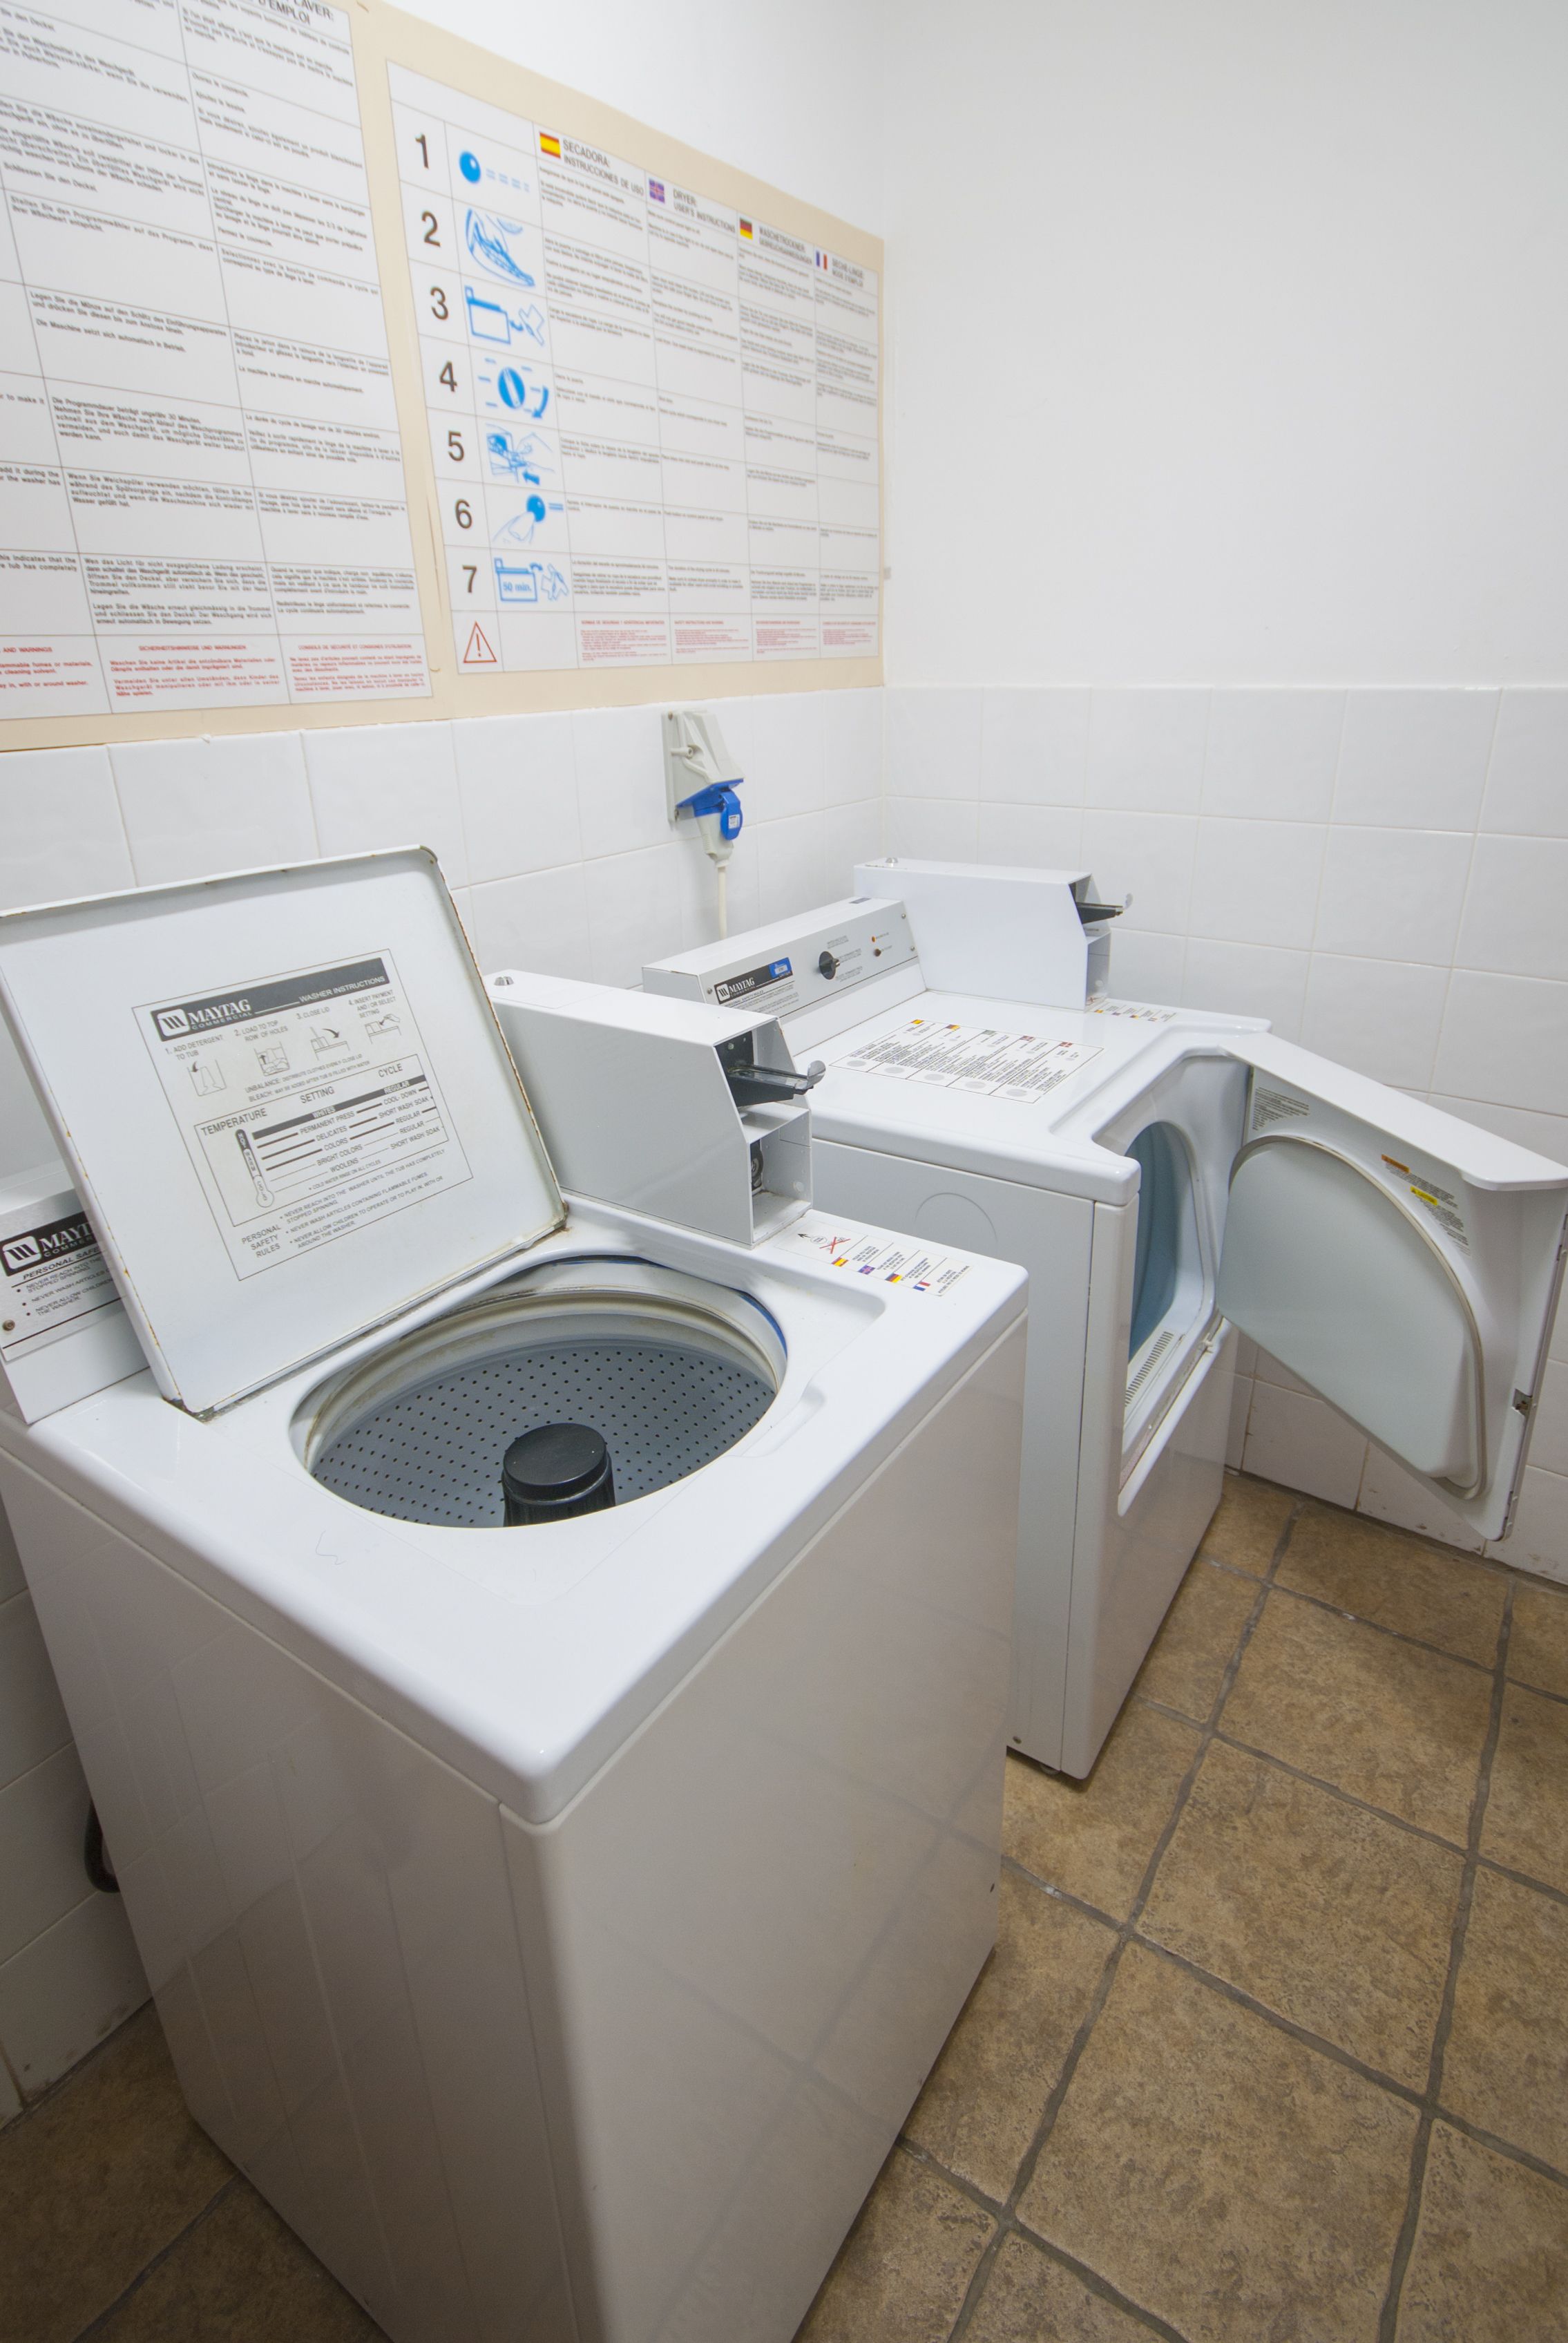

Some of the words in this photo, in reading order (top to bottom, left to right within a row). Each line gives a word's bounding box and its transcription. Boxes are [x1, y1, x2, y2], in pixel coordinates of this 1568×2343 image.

[416, 135, 429, 169] 1
[562, 137, 609, 169] SECADORA:
[564, 153, 618, 185] INSTRUCCIONES
[620, 178, 629, 190] DE
[630, 182, 644, 196] USO
[673, 188, 697, 207] DRYER:
[421, 211, 441, 247] 2
[696, 209, 736, 234] INSTRUCTIONS
[430, 287, 449, 321] 3
[439, 361, 458, 392] 4
[16, 394, 37, 404] make
[448, 430, 465, 462] 5
[6, 474, 19, 483] the
[21, 475, 46, 485] washer
[48, 478, 61, 486] has
[22, 468, 47, 479] during
[47, 470, 59, 479] the
[455, 499, 472, 529] 6
[8, 562, 21, 570] tub
[38, 563, 78, 573] completely
[13, 554, 46, 562] indicates
[462, 565, 477, 594] 7
[298, 988, 333, 1003] WASHER
[332, 975, 385, 994] INSTRUCTIONS
[729, 977, 755, 992] MAYTAG
[353, 994, 372, 1005] INSERT
[370, 989, 394, 1000] PAYMENT
[377, 996, 396, 1006] SELECT
[186, 998, 251, 1025] MAYTAG
[190, 1010, 253, 1031] COMMERCIAL
[302, 1008, 321, 1018] CLOSE
[358, 1007, 381, 1018] SETTING
[240, 1025, 258, 1035] LOAD
[257, 1022, 267, 1030] TO
[266, 1019, 279, 1028] TOP
[243, 1032, 259, 1043] ROW
[259, 1030, 269, 1038] OF
[268, 1025, 289, 1036] HOLES
[171, 1043, 187, 1054] ADD
[186, 1034, 224, 1050] DETERGENT
[175, 1052, 187, 1061] TO
[184, 1049, 200, 1059] TUB
[244, 1077, 280, 1094] UNBALANCE:
[247, 1090, 274, 1103] BLEACH:
[200, 1107, 268, 1137] TEMPERATURE
[299, 1085, 335, 1104] SETTING
[376, 1063, 403, 1078] CYCLE
[312, 1105, 336, 1119] WHITES
[383, 1079, 410, 1094] REGULAR
[298, 1117, 336, 1135] PERMANENT
[335, 1110, 355, 1122] PRESS
[315, 1124, 347, 1141] DELICATES
[377, 1107, 397, 1119] SHORT
[396, 1101, 413, 1112] WASH
[413, 1095, 429, 1106] SOAK
[236, 1131, 248, 1149] HOT
[323, 1137, 349, 1151] COLORS
[394, 1110, 421, 1125] REGULAR
[316, 1152, 340, 1166] BRIGHT
[338, 1143, 363, 1157] COLORS
[398, 1120, 425, 1135] REGULAR
[329, 1157, 359, 1174] WOOLENS
[389, 1137, 409, 1150] SHORT
[408, 1131, 425, 1143] WASH
[425, 1125, 440, 1136] SOAK
[283, 1206, 303, 1218] NEVER
[303, 1198, 323, 1211] REACH
[322, 1193, 336, 1202] INTO
[335, 1188, 347, 1197] THE
[347, 1179, 370, 1192] WASHER
[384, 1168, 395, 1177] THE
[394, 1164, 405, 1173] TUB
[404, 1160, 416, 1168] HAS
[414, 1148, 446, 1164] COMPLETELY
[285, 1209, 312, 1224] STOPPED
[289, 1221, 309, 1233] NEVER
[309, 1214, 326, 1225] WASH
[325, 1203, 352, 1219] ARTICLES
[350, 1191, 382, 1208] CONTAINING
[381, 1178, 412, 1195] FLAMMABLE
[293, 1231, 313, 1244] NEVER
[312, 1222, 332, 1235] ALLOW
[331, 1211, 358, 1227] CHILDREN
[365, 1197, 390, 1213] OPERATE
[403, 1186, 417, 1196] PLAY
[423, 1178, 436, 1188] WITH
[39, 1222, 95, 1252] MAYT
[240, 1222, 281, 1244] PERSONAL
[249, 1233, 279, 1251] SAFETY
[297, 1234, 321, 1249] AROUND
[321, 1229, 332, 1239] THE
[44, 1236, 94, 1258] COMMER
[254, 1242, 281, 1258] RULES
[23, 1257, 73, 1279] PERSONAL
[76, 1246, 101, 1260] SAFE
